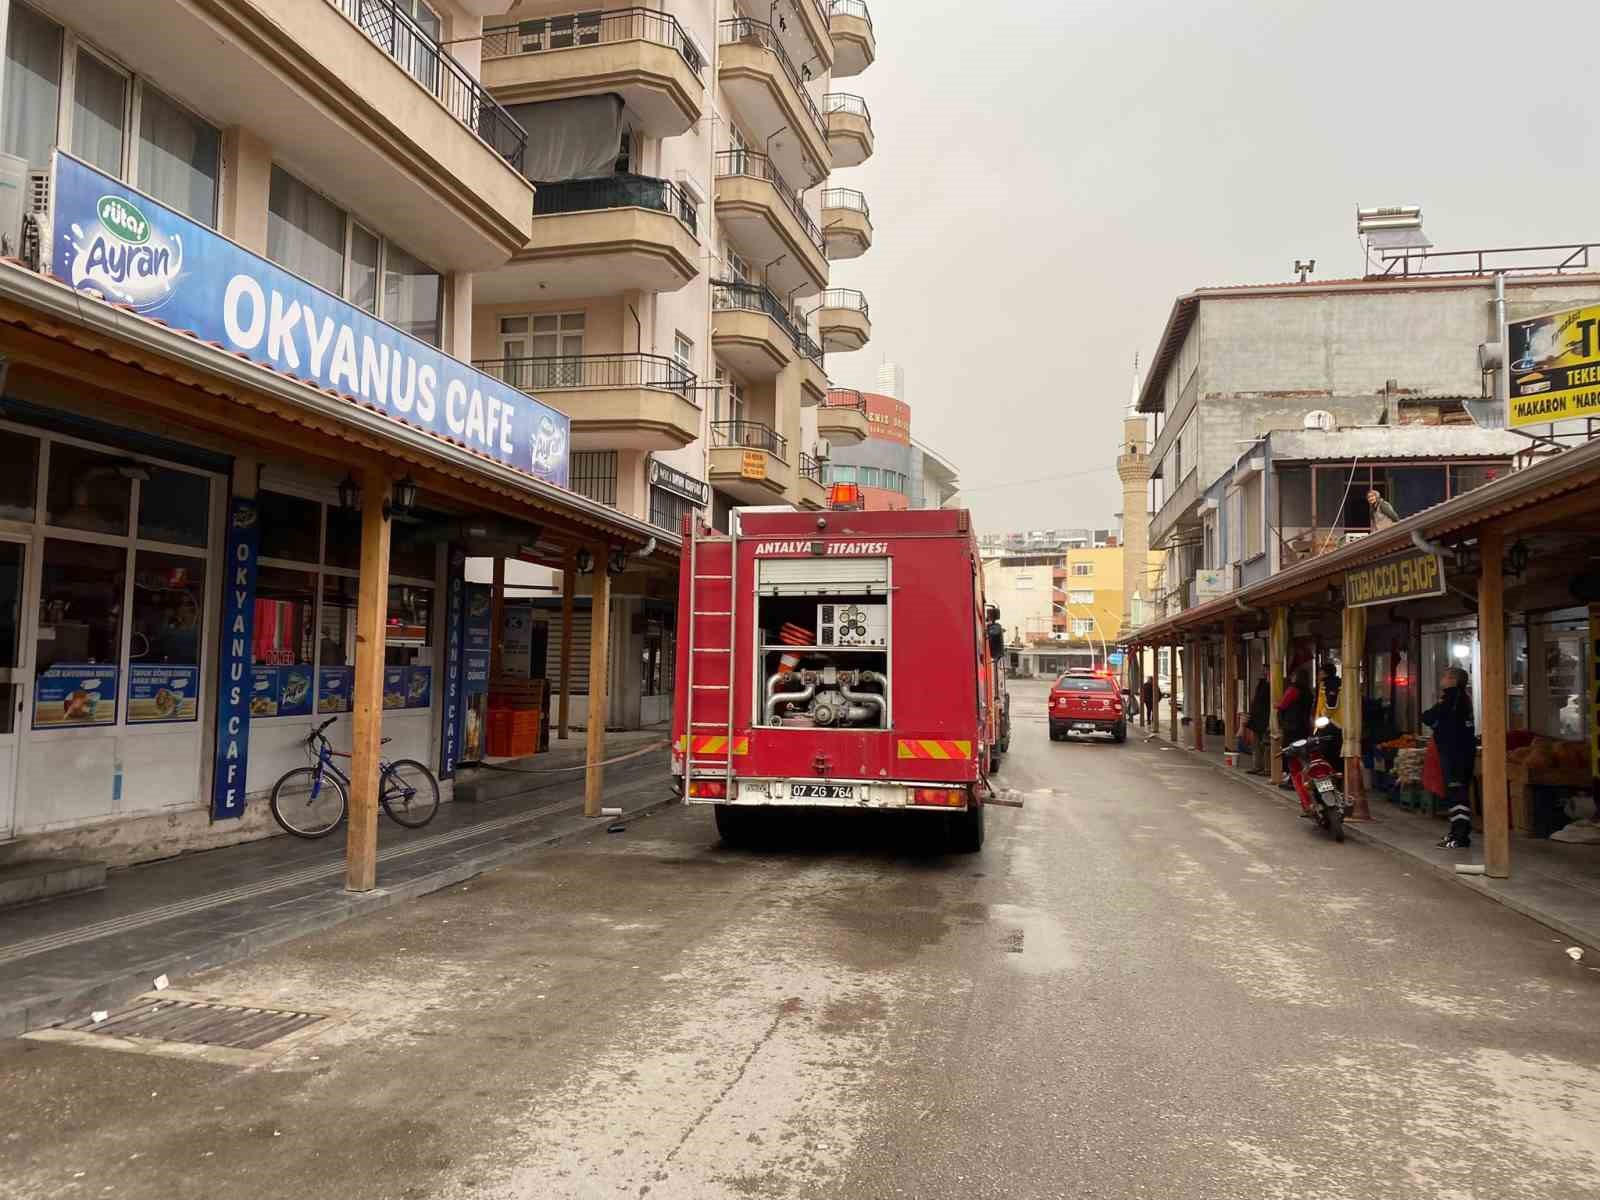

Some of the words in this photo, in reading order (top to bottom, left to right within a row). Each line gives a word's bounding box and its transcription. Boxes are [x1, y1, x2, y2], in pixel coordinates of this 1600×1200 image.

[85, 236, 169, 283] Ayran
[223, 273, 437, 422] OKYANUS
[445, 378, 515, 454] CAFE
[755, 541, 812, 555] ANTALYA
[1348, 563, 1399, 602] TOBACCO
[1401, 553, 1437, 593] SHOP
[230, 543, 249, 705] OKYANUS
[225, 716, 240, 809] CAFE
[447, 705, 456, 773] CAFE
[793, 785, 807, 797] 07
[811, 786, 827, 797] ZG
[832, 786, 852, 798] 764
